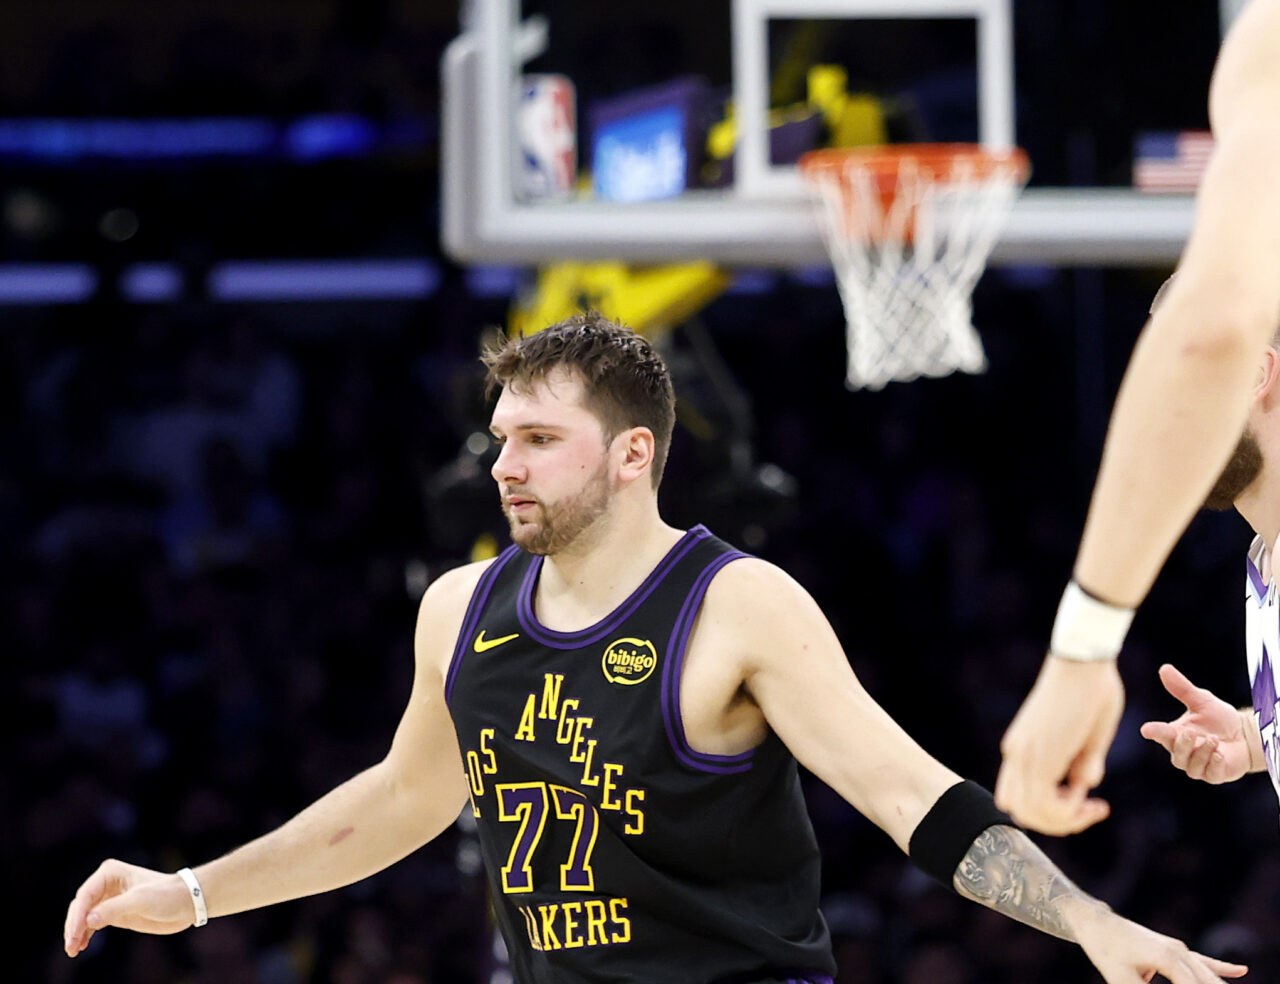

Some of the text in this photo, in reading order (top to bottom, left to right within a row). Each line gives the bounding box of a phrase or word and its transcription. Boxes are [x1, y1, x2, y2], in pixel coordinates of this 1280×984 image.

[607, 648, 653, 673] bibigo
[514, 672, 646, 836] ANGELES
[495, 781, 600, 894] 77
